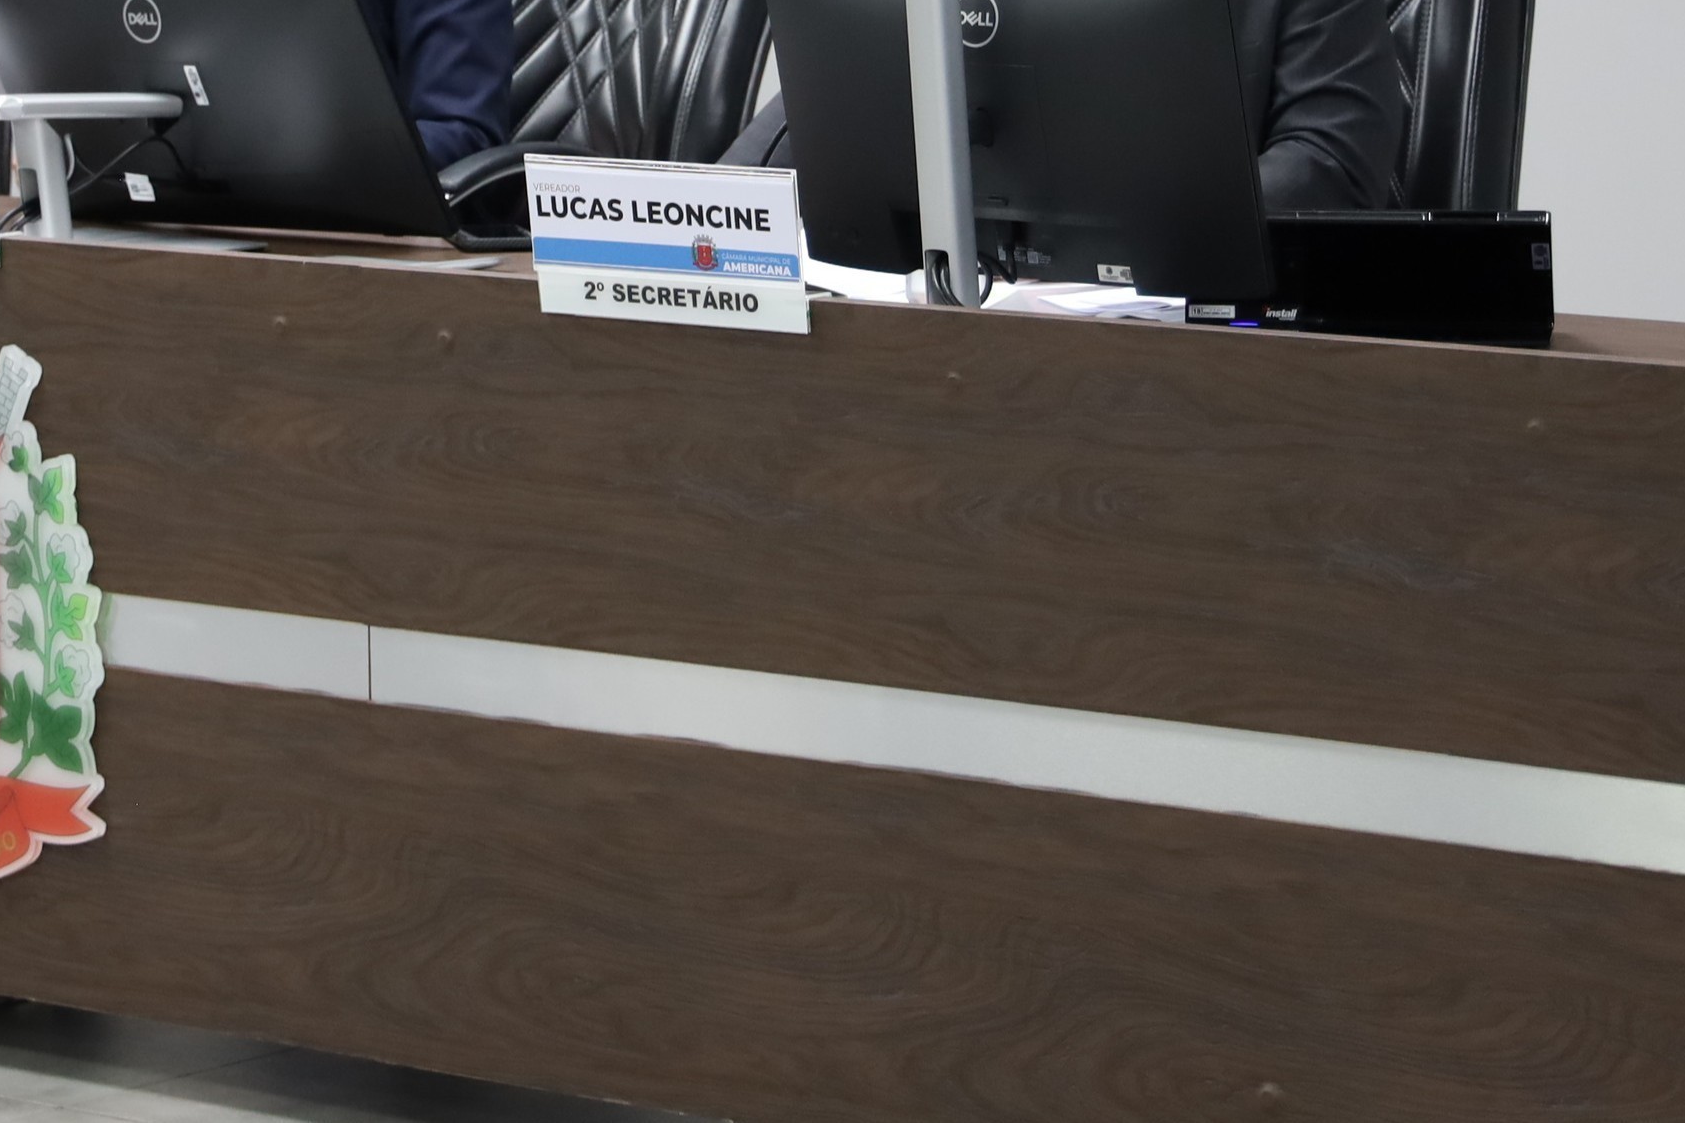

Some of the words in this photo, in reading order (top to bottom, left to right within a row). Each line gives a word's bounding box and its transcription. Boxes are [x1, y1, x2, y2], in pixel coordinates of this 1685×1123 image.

[128, 12, 157, 25] DELL
[533, 182, 580, 193] VEREADOR
[536, 195, 623, 222] LUCAS
[631, 200, 771, 232] LEONCINE
[723, 261, 792, 277] AMERICANA
[584, 281, 605, 300] 2º
[612, 283, 759, 313] SECRETÁRIO
